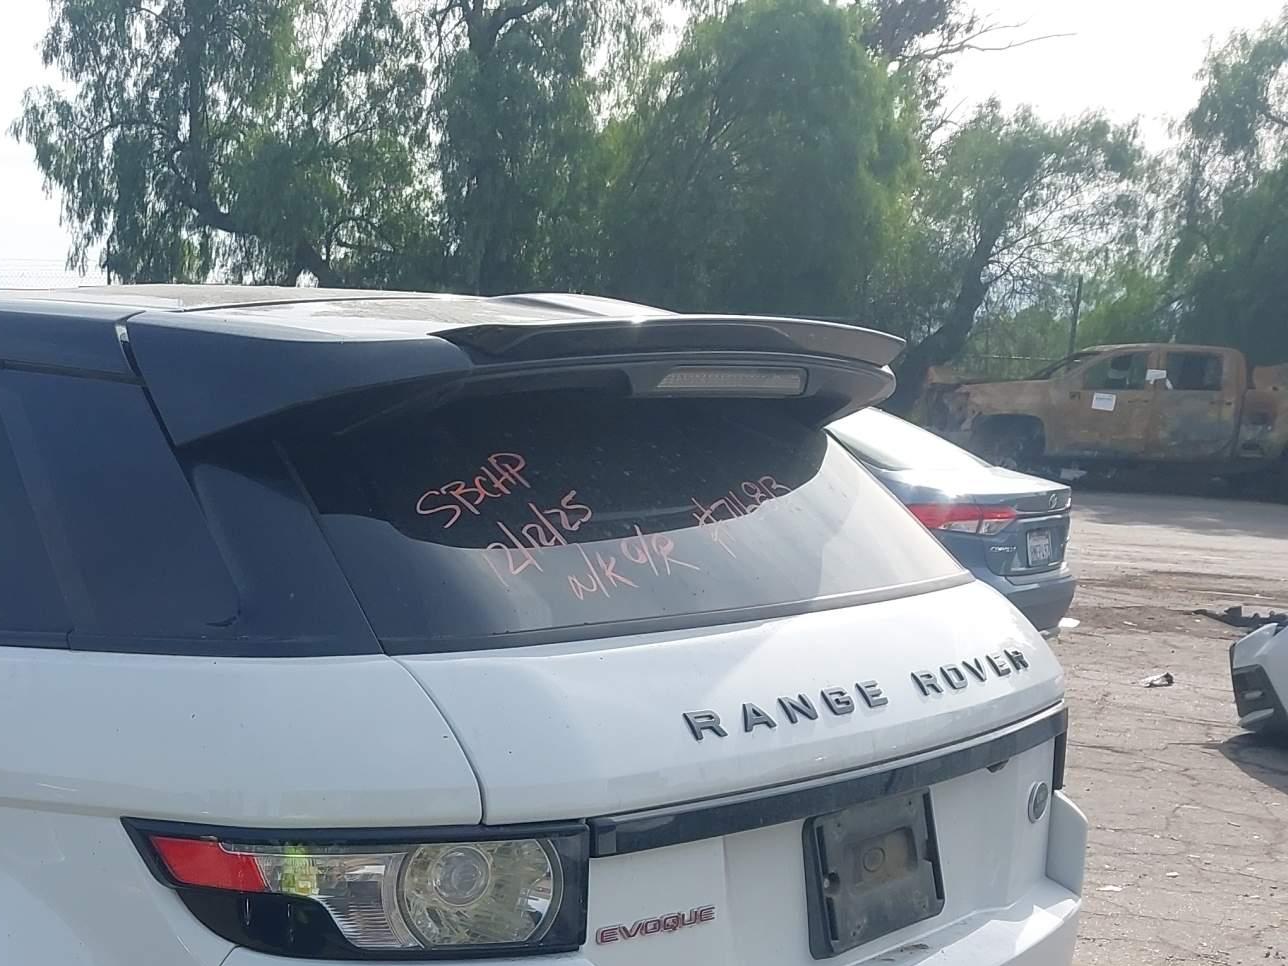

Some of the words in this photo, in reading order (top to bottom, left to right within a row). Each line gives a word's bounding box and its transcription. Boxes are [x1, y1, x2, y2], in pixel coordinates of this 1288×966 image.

[683, 680, 889, 741] RANGE
[911, 647, 1030, 697] ROVER
[597, 905, 716, 945] EVOQUE
